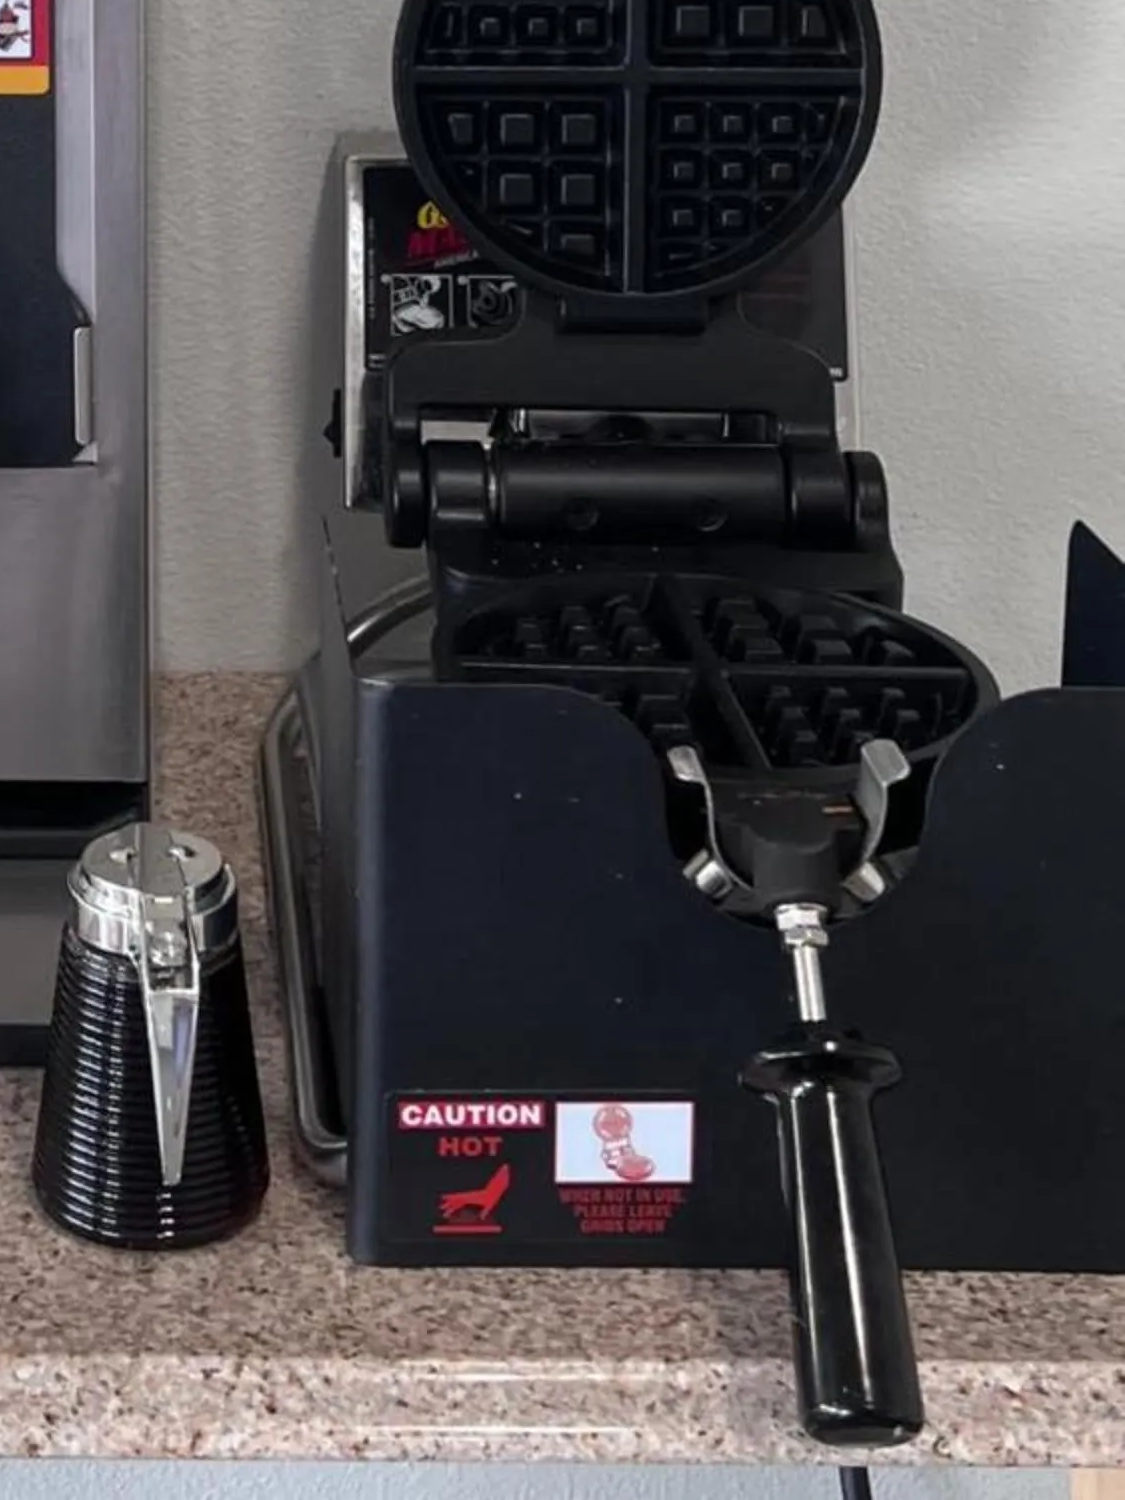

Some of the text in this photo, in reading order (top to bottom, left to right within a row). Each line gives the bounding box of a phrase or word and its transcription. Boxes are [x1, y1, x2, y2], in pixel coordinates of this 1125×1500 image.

[400, 1104, 542, 1126] CAUTION
[439, 1137, 503, 1156] HOT
[559, 1188, 601, 1203] WHEN
[604, 1188, 632, 1203] NOT
[635, 1188, 651, 1202] IN
[574, 1204, 673, 1218] PLEASE LEAVE
[627, 1219, 665, 1233] OPEN
